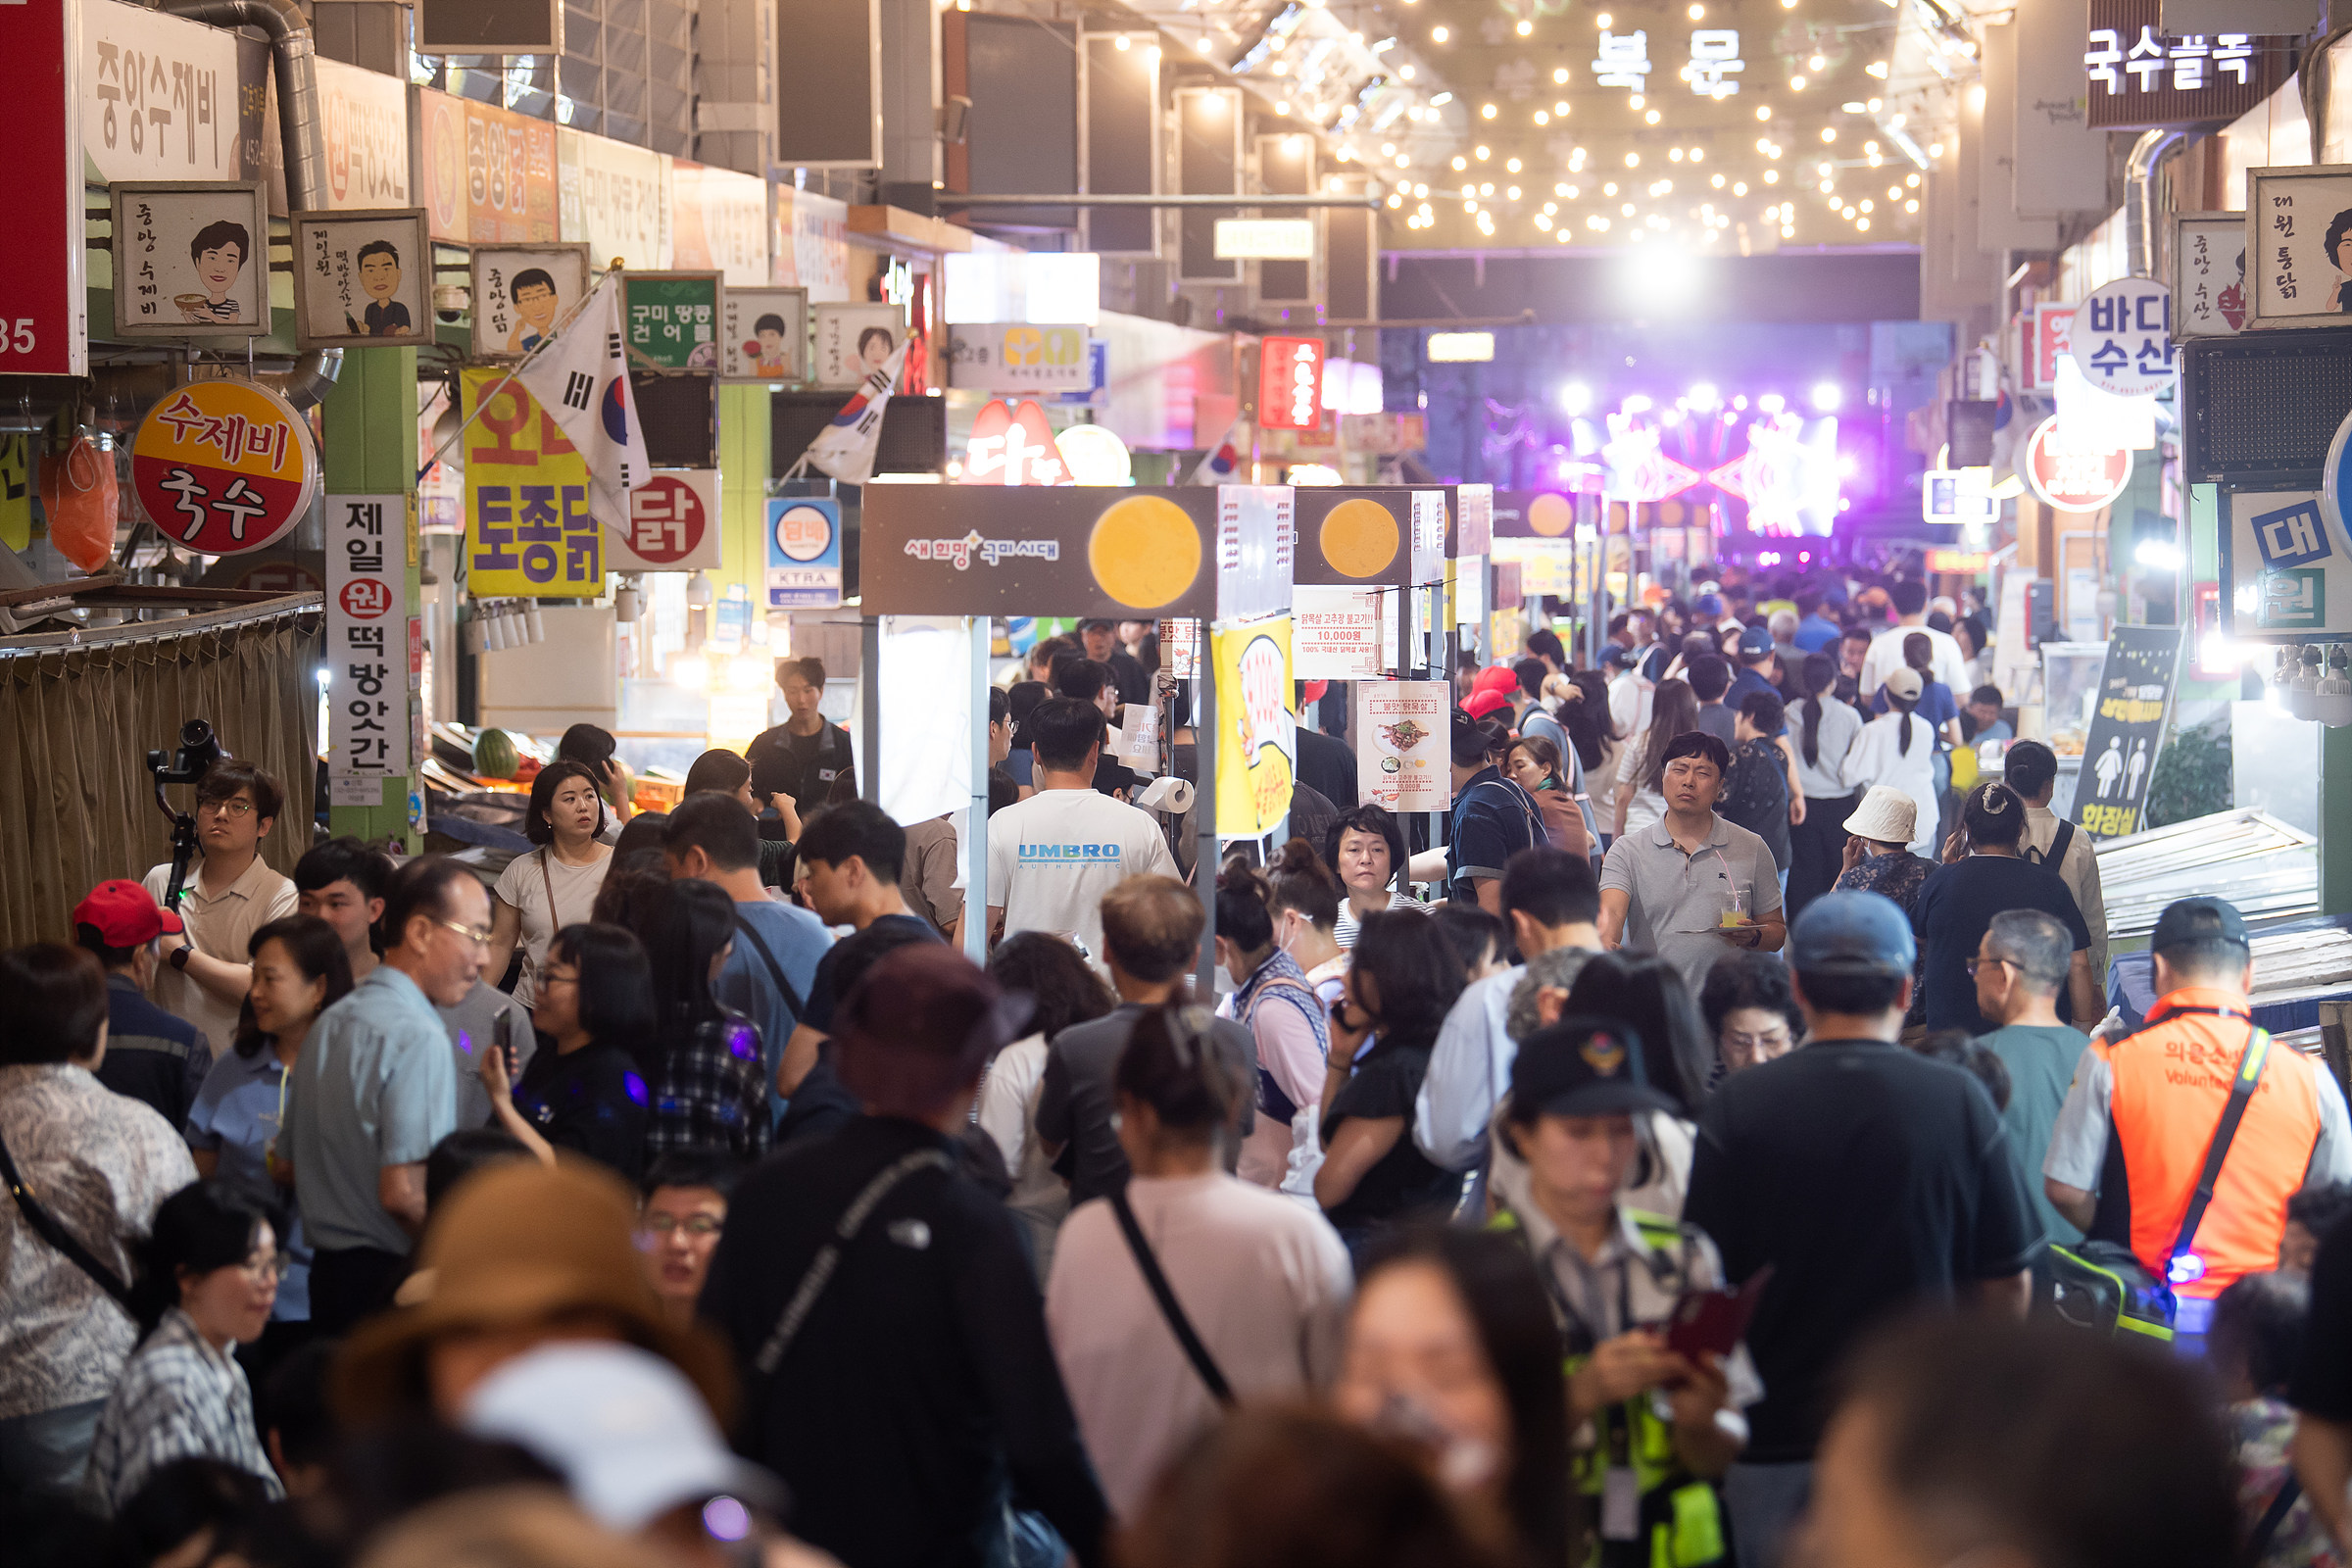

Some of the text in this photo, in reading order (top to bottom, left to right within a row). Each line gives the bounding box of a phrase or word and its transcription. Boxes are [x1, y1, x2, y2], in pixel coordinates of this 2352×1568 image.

[97, 40, 219, 170] 중앙수제비
[136, 203, 158, 316] 중앙수제비
[2273, 195, 2297, 299] 대원통닭
[632, 304, 711, 323] 구미 땅콩
[2090, 338, 2176, 376] 수산
[158, 392, 290, 473] 수제비
[160, 467, 267, 542] 국수
[632, 487, 694, 552] 닭
[473, 485, 599, 584] 토종닭
[779, 572, 827, 584] KTRA
[1301, 613, 1322, 625] 닭목살
[1324, 613, 1345, 625] 고추장
[1317, 630, 1361, 641] 10,000원
[2081, 803, 2136, 837] 화장실
[1018, 844, 1121, 858] UMBRO
